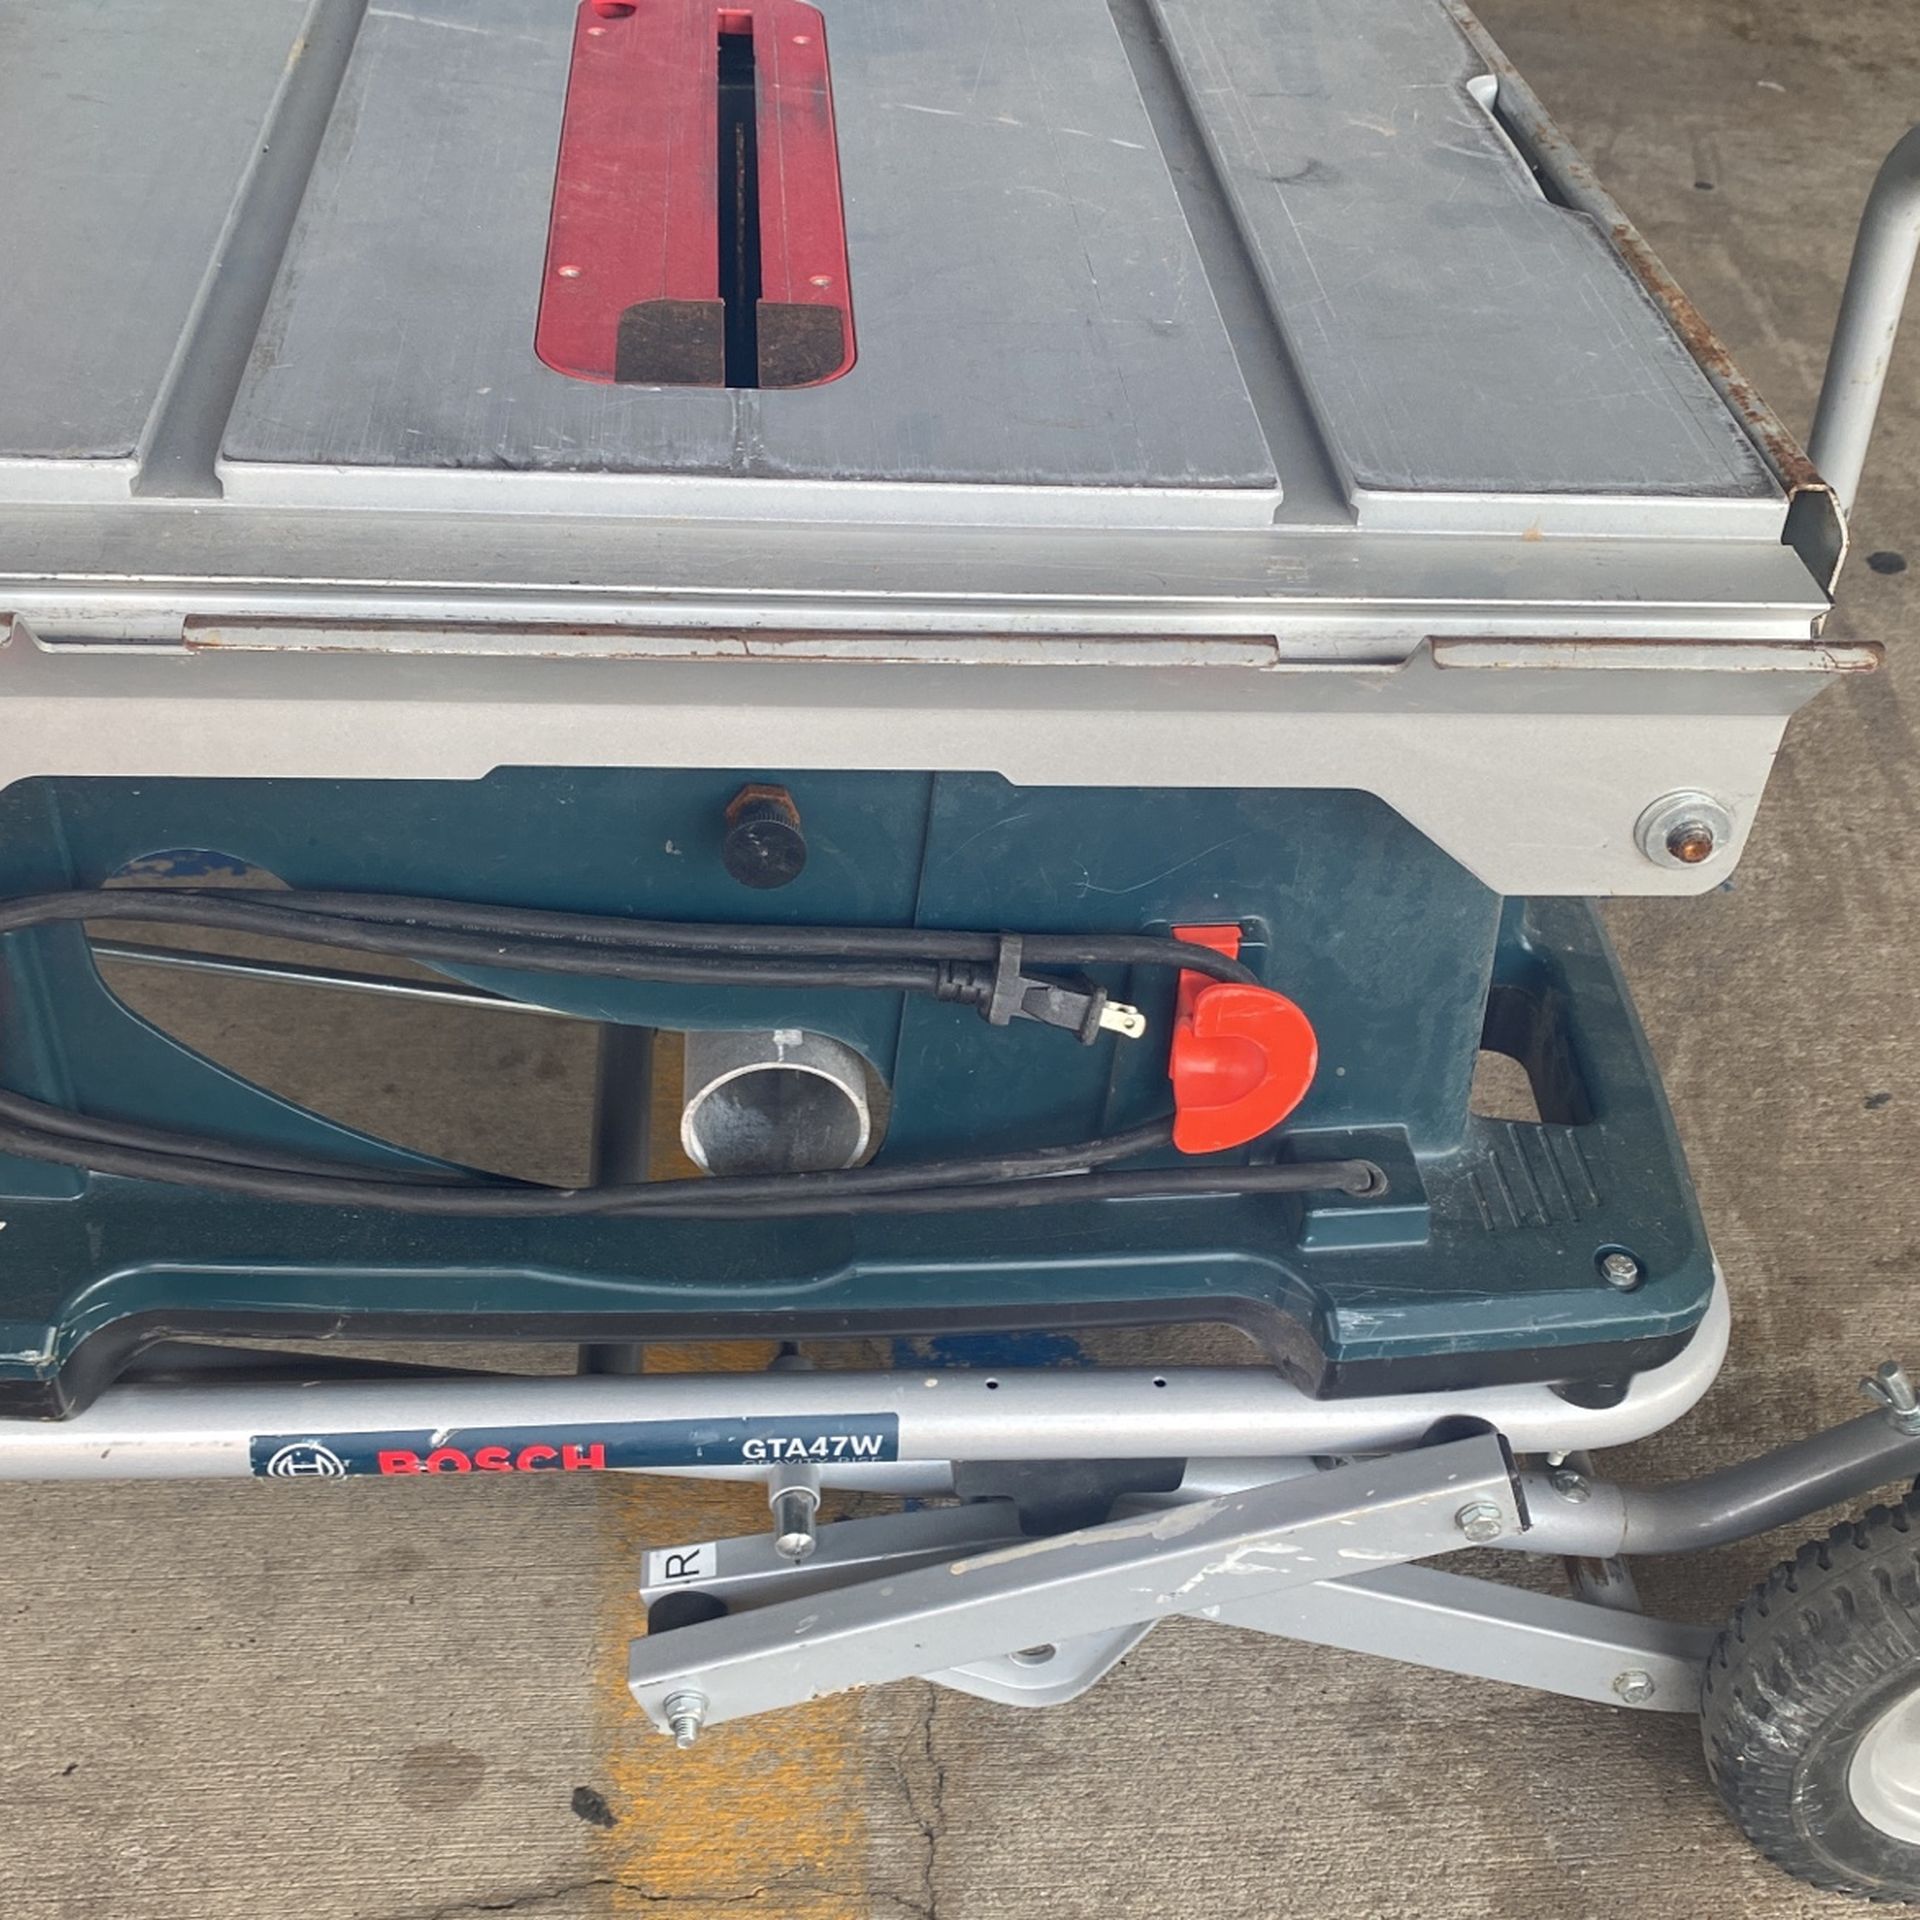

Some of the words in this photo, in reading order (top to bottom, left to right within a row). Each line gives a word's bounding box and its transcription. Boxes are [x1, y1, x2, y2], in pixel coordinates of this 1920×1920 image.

[378, 1443, 605, 1476] BOSCH
[742, 1435, 884, 1459] GTA47W
[666, 1549, 700, 1579] R
